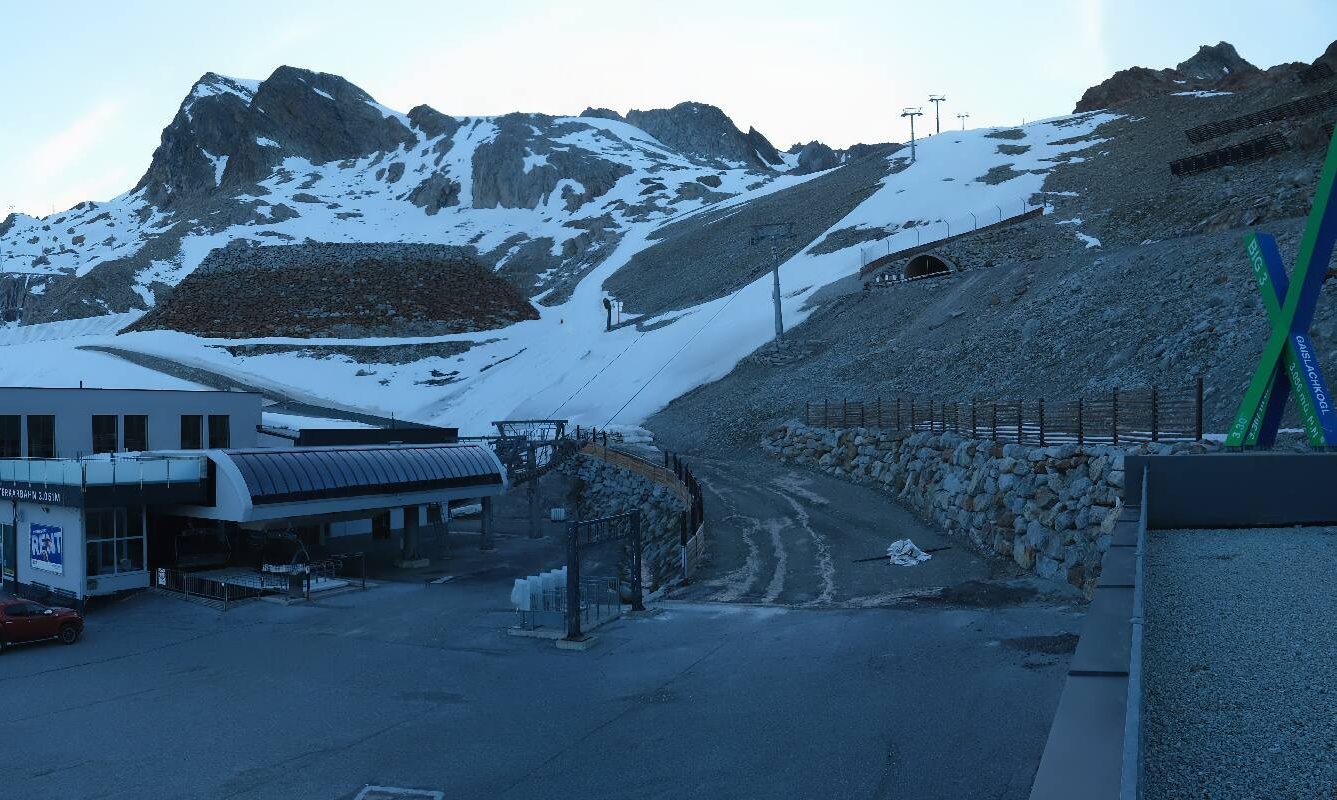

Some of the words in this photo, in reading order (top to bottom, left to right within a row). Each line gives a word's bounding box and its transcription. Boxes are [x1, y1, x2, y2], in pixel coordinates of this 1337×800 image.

[1247, 237, 1263, 272] BIG
[1259, 272, 1268, 286] 3
[1296, 335, 1330, 415] GAISLACHKOGL
